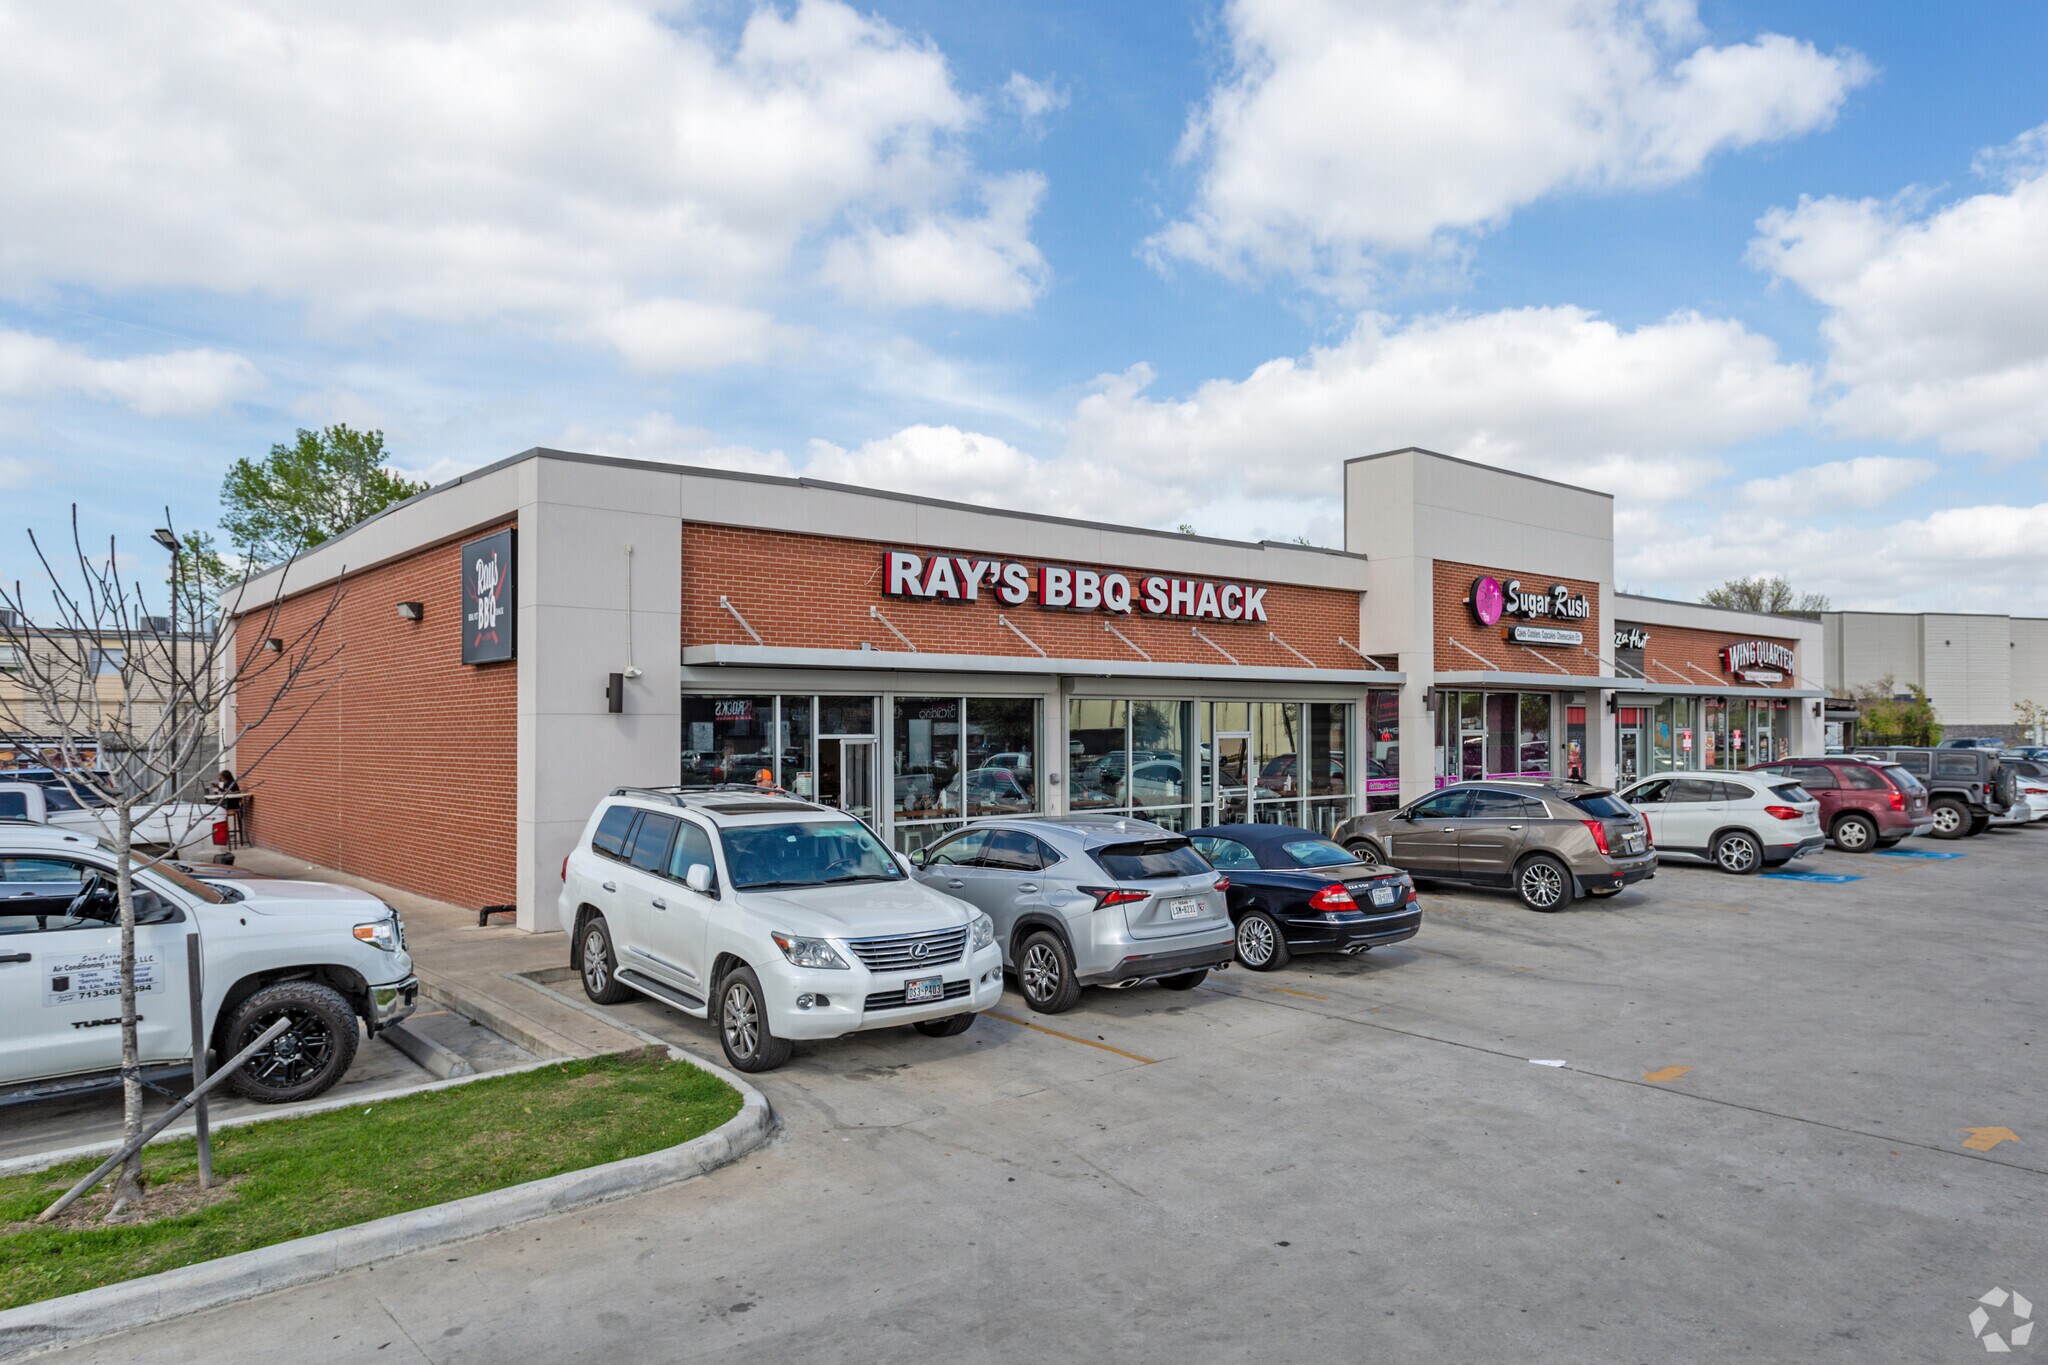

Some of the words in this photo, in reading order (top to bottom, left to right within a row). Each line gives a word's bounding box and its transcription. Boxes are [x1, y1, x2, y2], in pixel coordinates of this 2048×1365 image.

[475, 552, 499, 595] Ray's
[886, 551, 1030, 605] RAY'S
[1040, 566, 1132, 615] BBQ
[1141, 576, 1269, 622] SHACK
[478, 588, 496, 630] BBQ
[1506, 580, 1551, 618] Sugar
[1554, 585, 1590, 618] Rush
[1629, 628, 1651, 649] Hut
[1729, 641, 1756, 672] WING
[1756, 641, 1795, 676] QUARTER
[53, 965, 62, 973] Air
[64, 961, 105, 972] Conditioning
